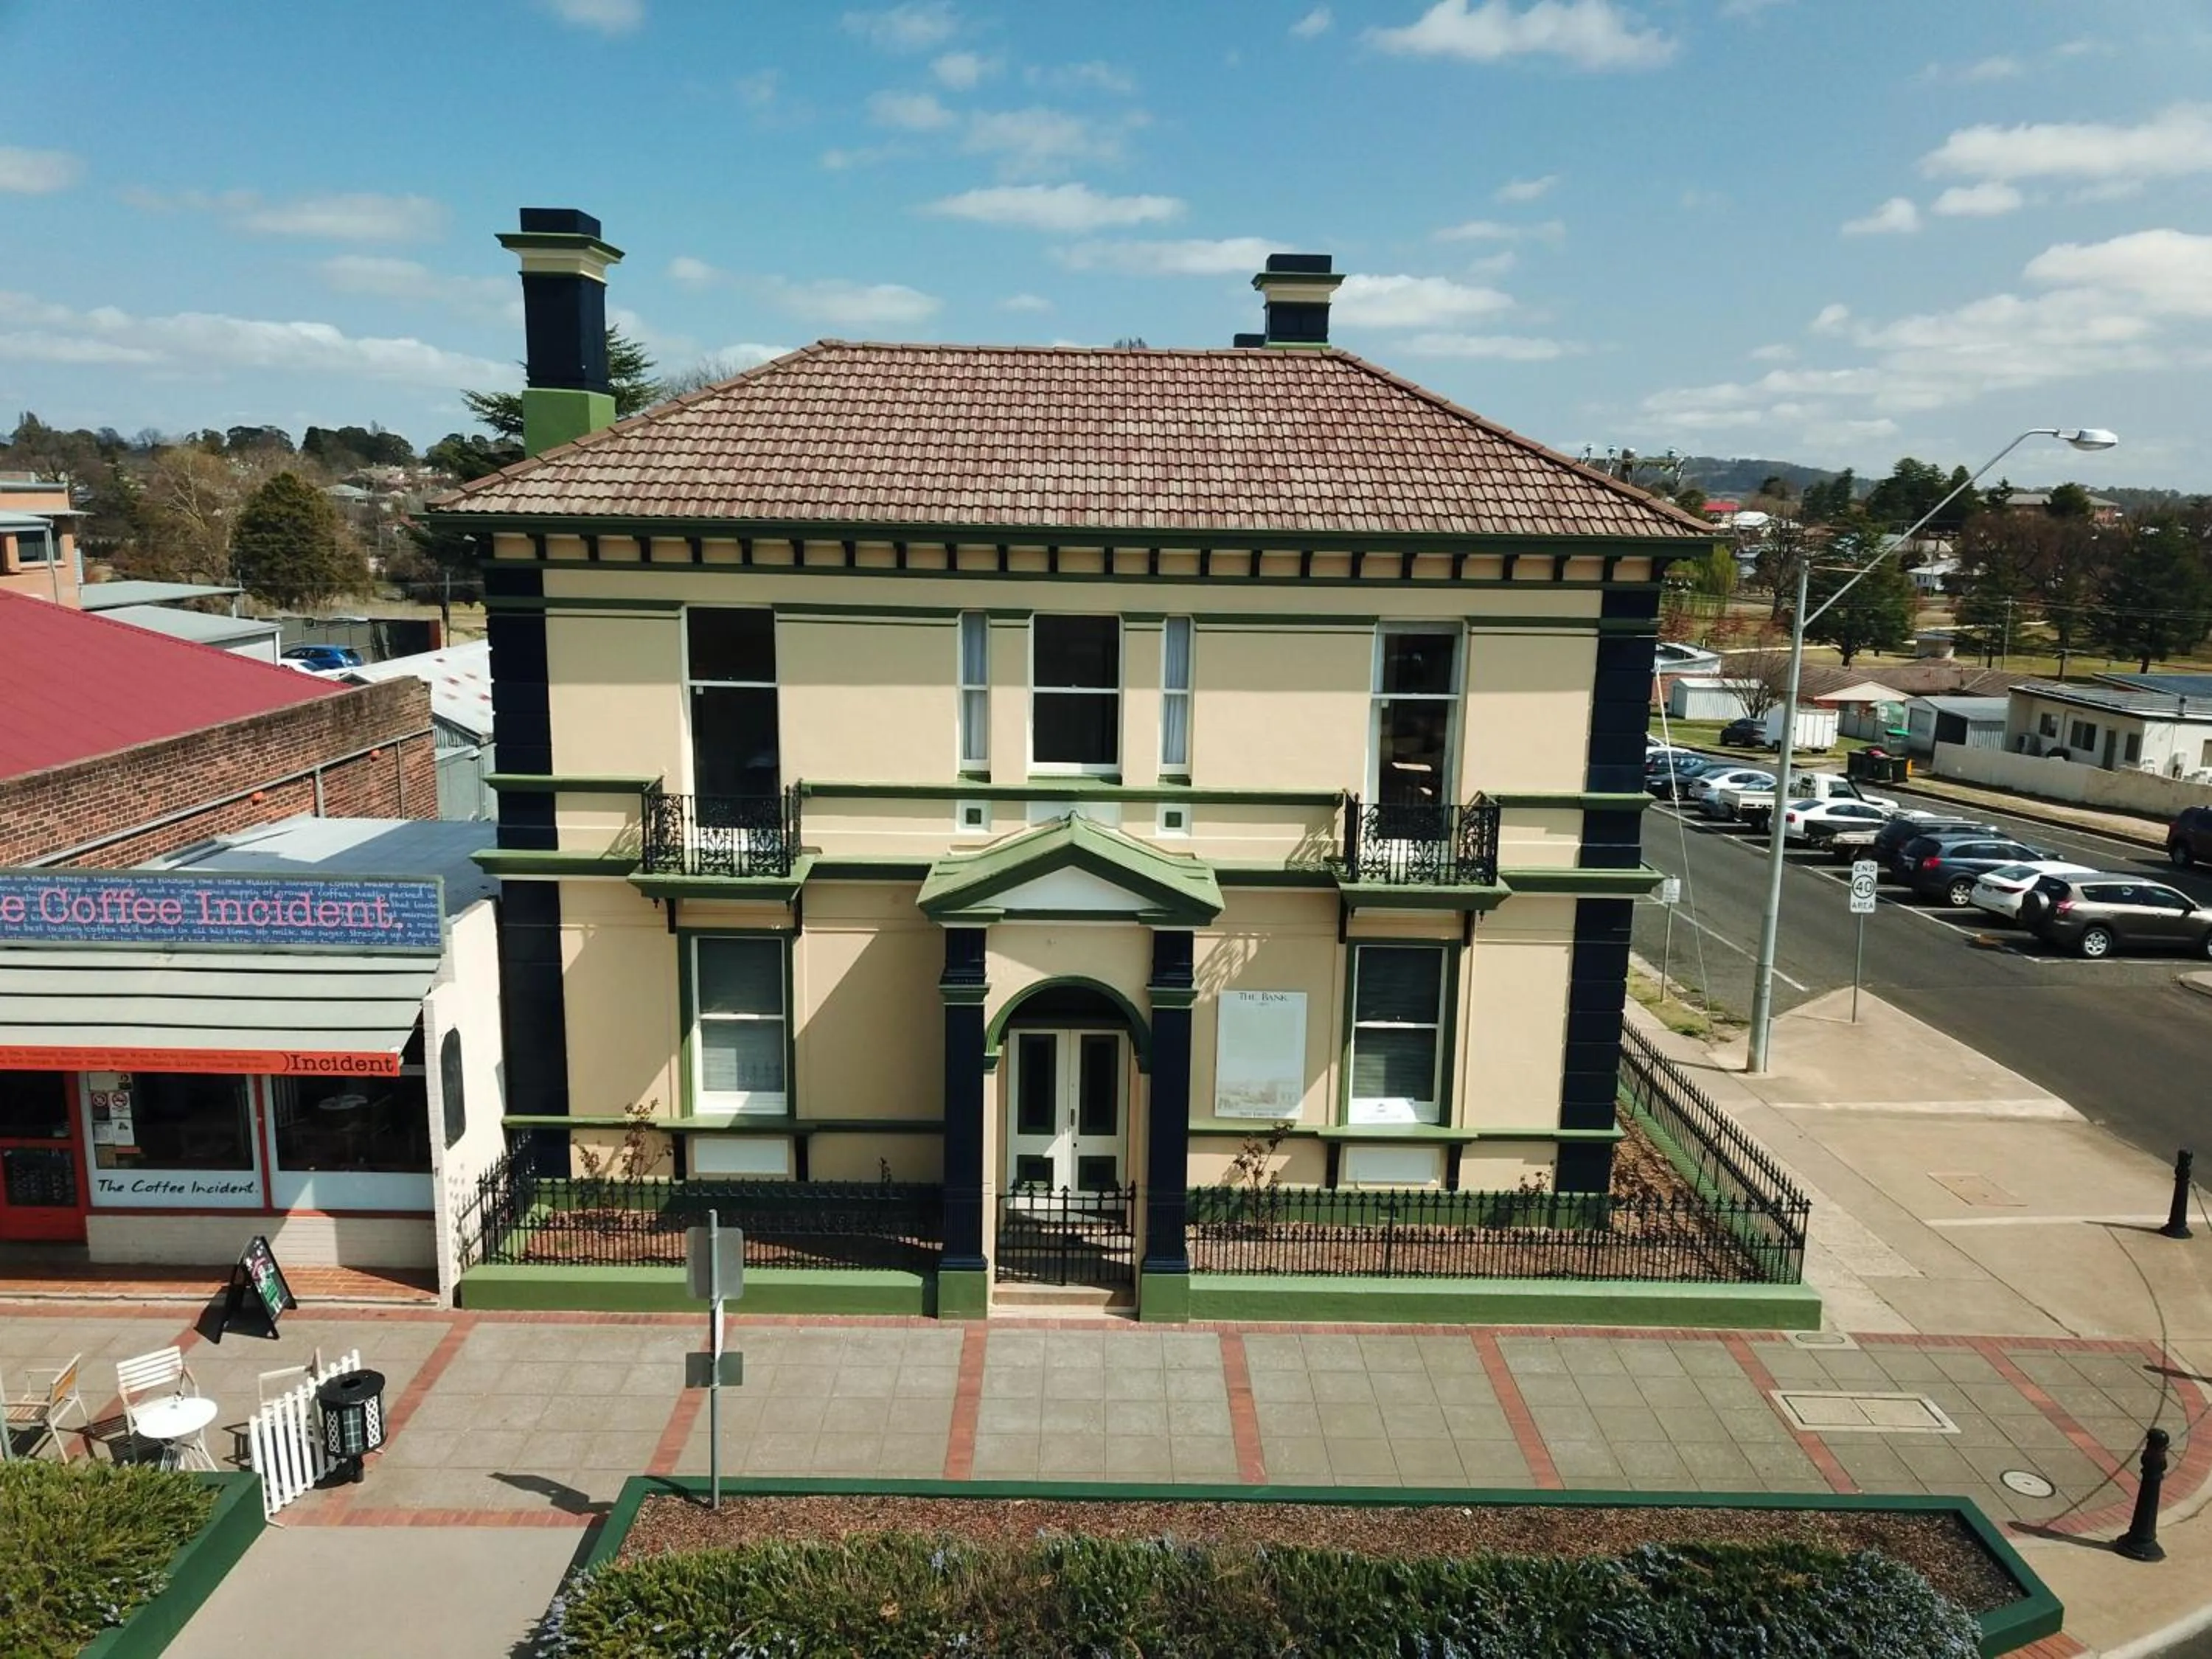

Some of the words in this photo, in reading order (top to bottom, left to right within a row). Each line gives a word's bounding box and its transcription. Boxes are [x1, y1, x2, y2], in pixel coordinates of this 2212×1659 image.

[1854, 864, 1875, 872] END
[1855, 881, 1873, 893] 40
[39, 886, 183, 925] Coffee
[1239, 992, 1256, 1001] THE
[1262, 992, 1287, 1001] BANK
[98, 1179, 125, 1192] The
[131, 1180, 185, 1193] Coffee
